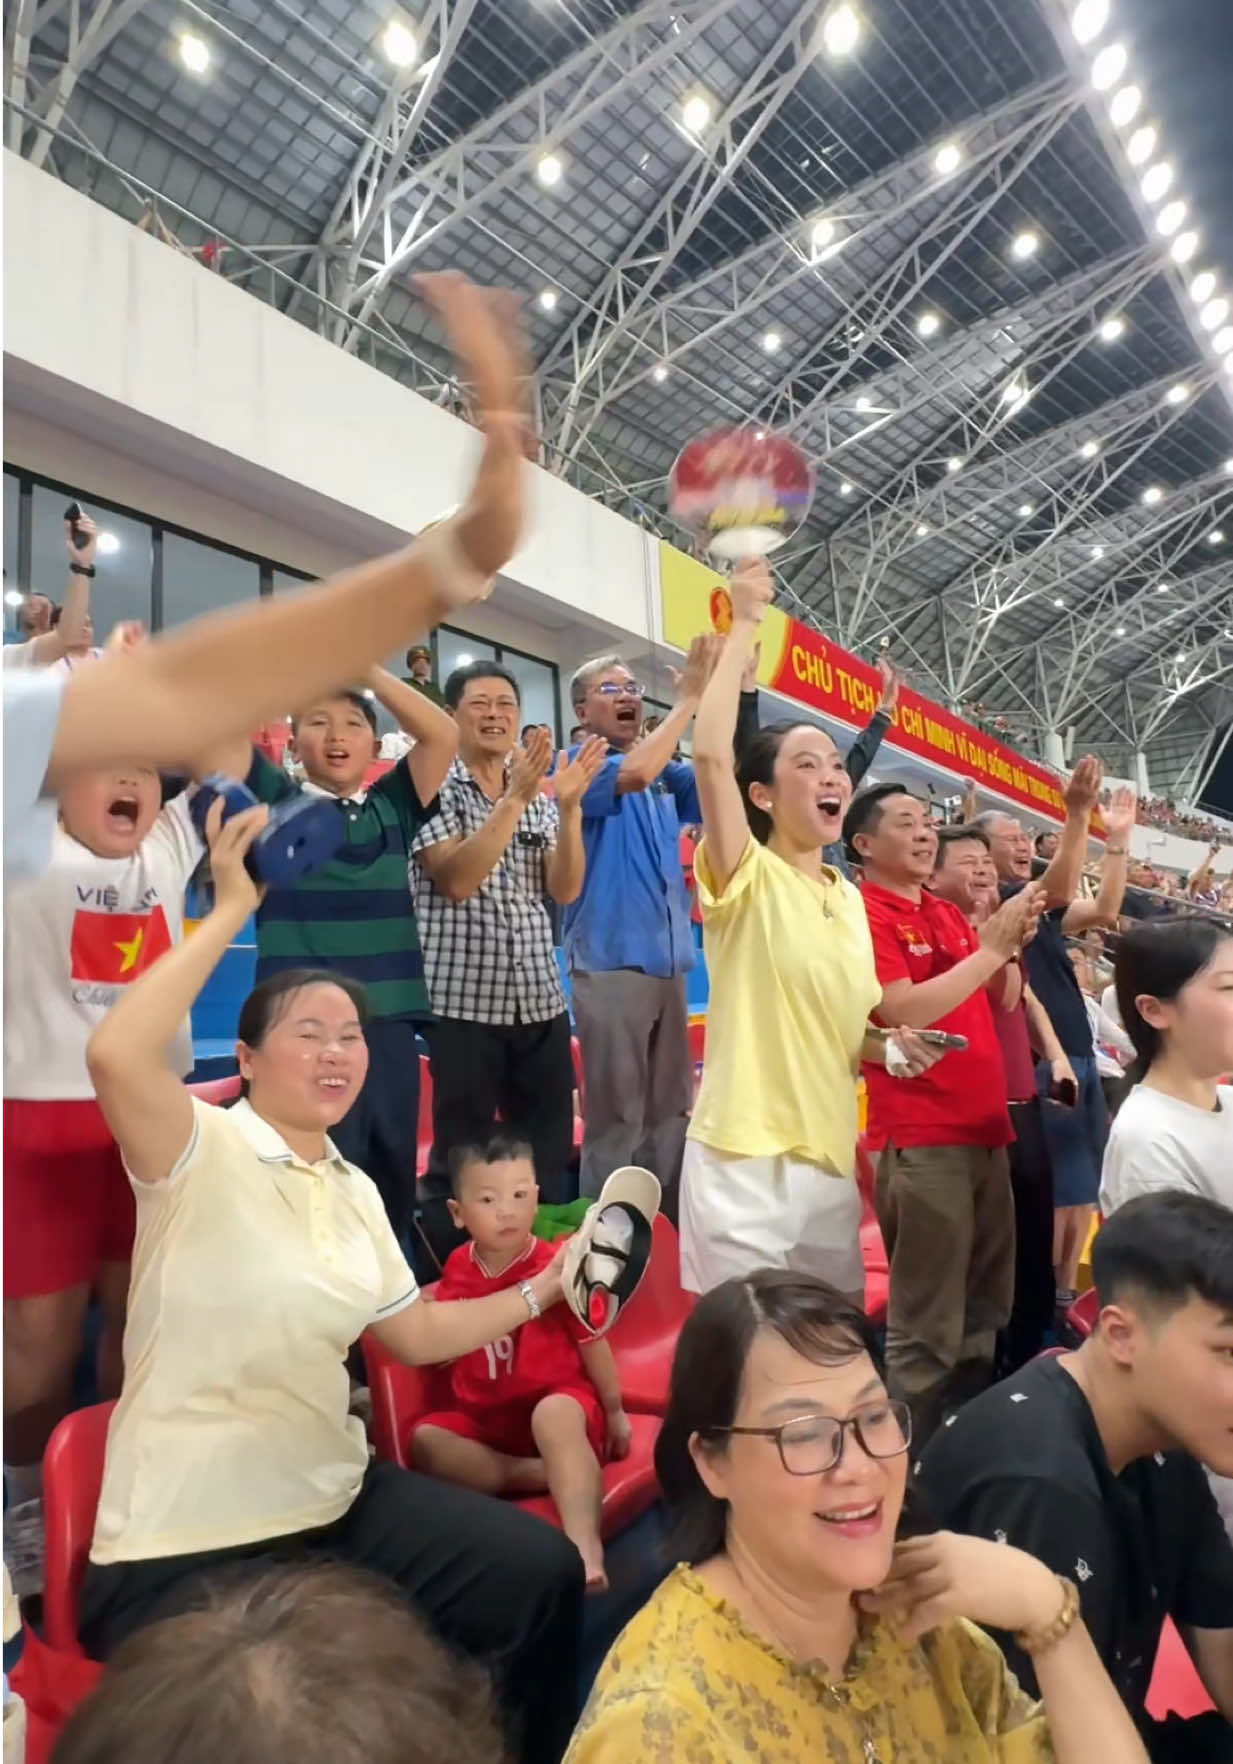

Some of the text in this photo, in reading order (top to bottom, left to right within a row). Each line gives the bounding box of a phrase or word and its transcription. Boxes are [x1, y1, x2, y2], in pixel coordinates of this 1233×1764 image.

[792, 644, 833, 694] CHỦ
[835, 667, 875, 716] TỊCH
[901, 704, 925, 741] CHÍ
[76, 884, 121, 912] VIỆ
[483, 1335, 514, 1380] 19
